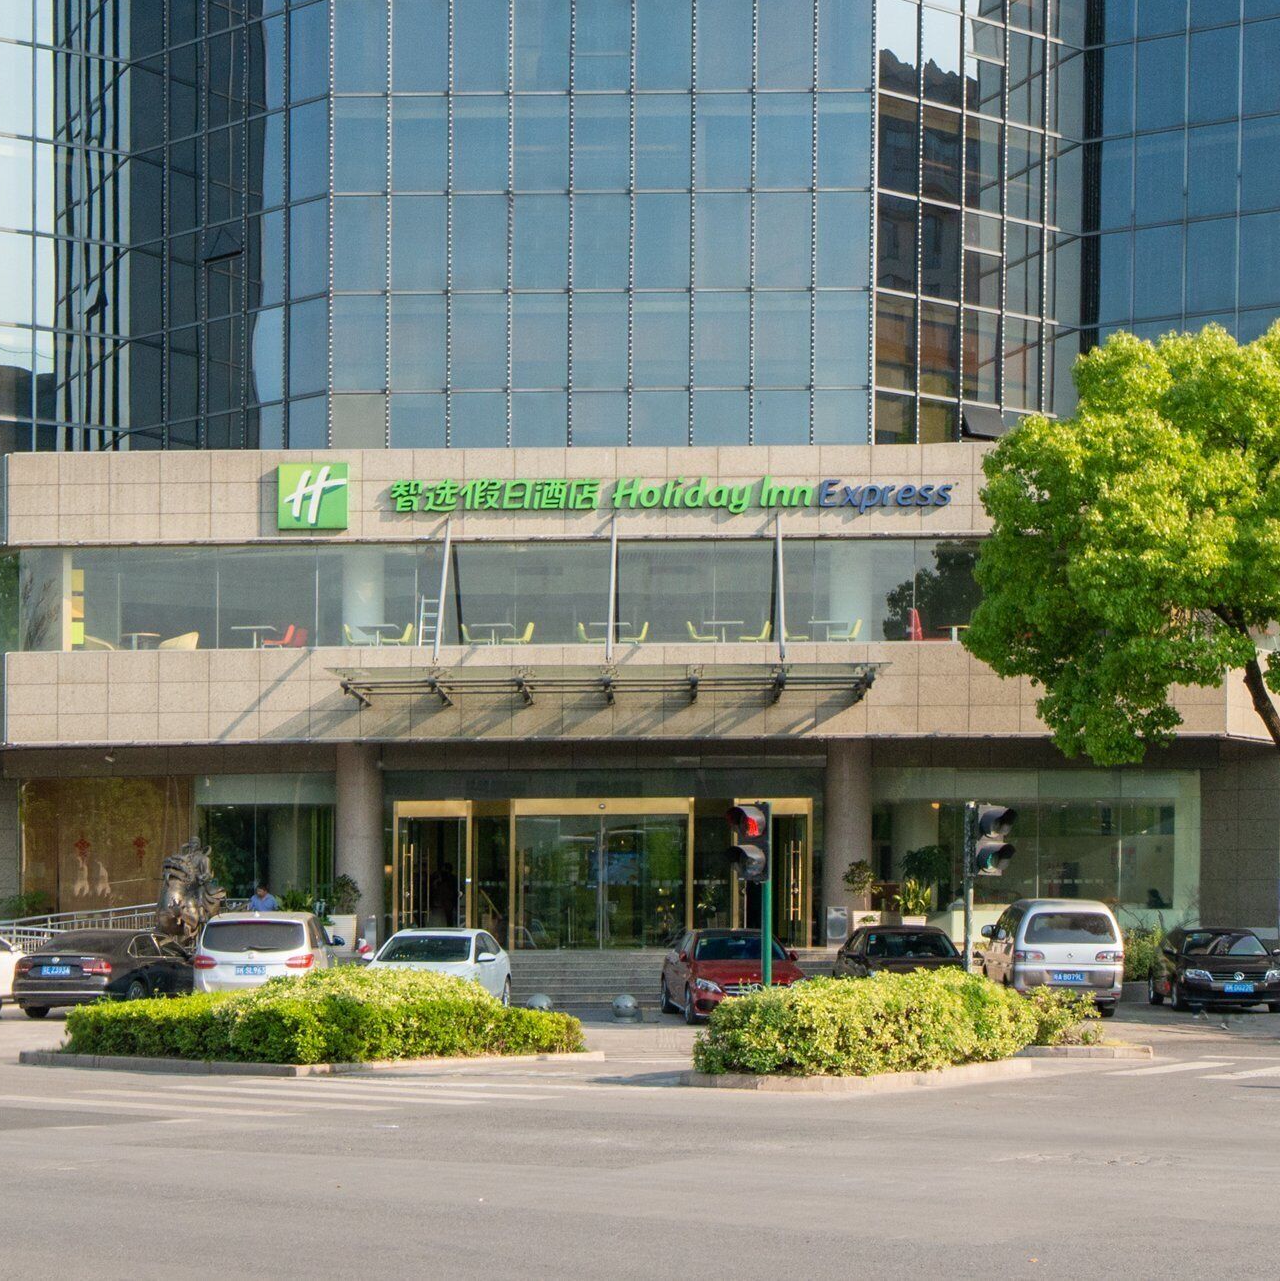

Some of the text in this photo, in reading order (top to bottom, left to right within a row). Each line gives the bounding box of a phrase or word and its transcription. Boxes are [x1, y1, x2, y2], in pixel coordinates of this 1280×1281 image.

[390, 475, 953, 515] 智选假日酒店 Holiday Inn Express
